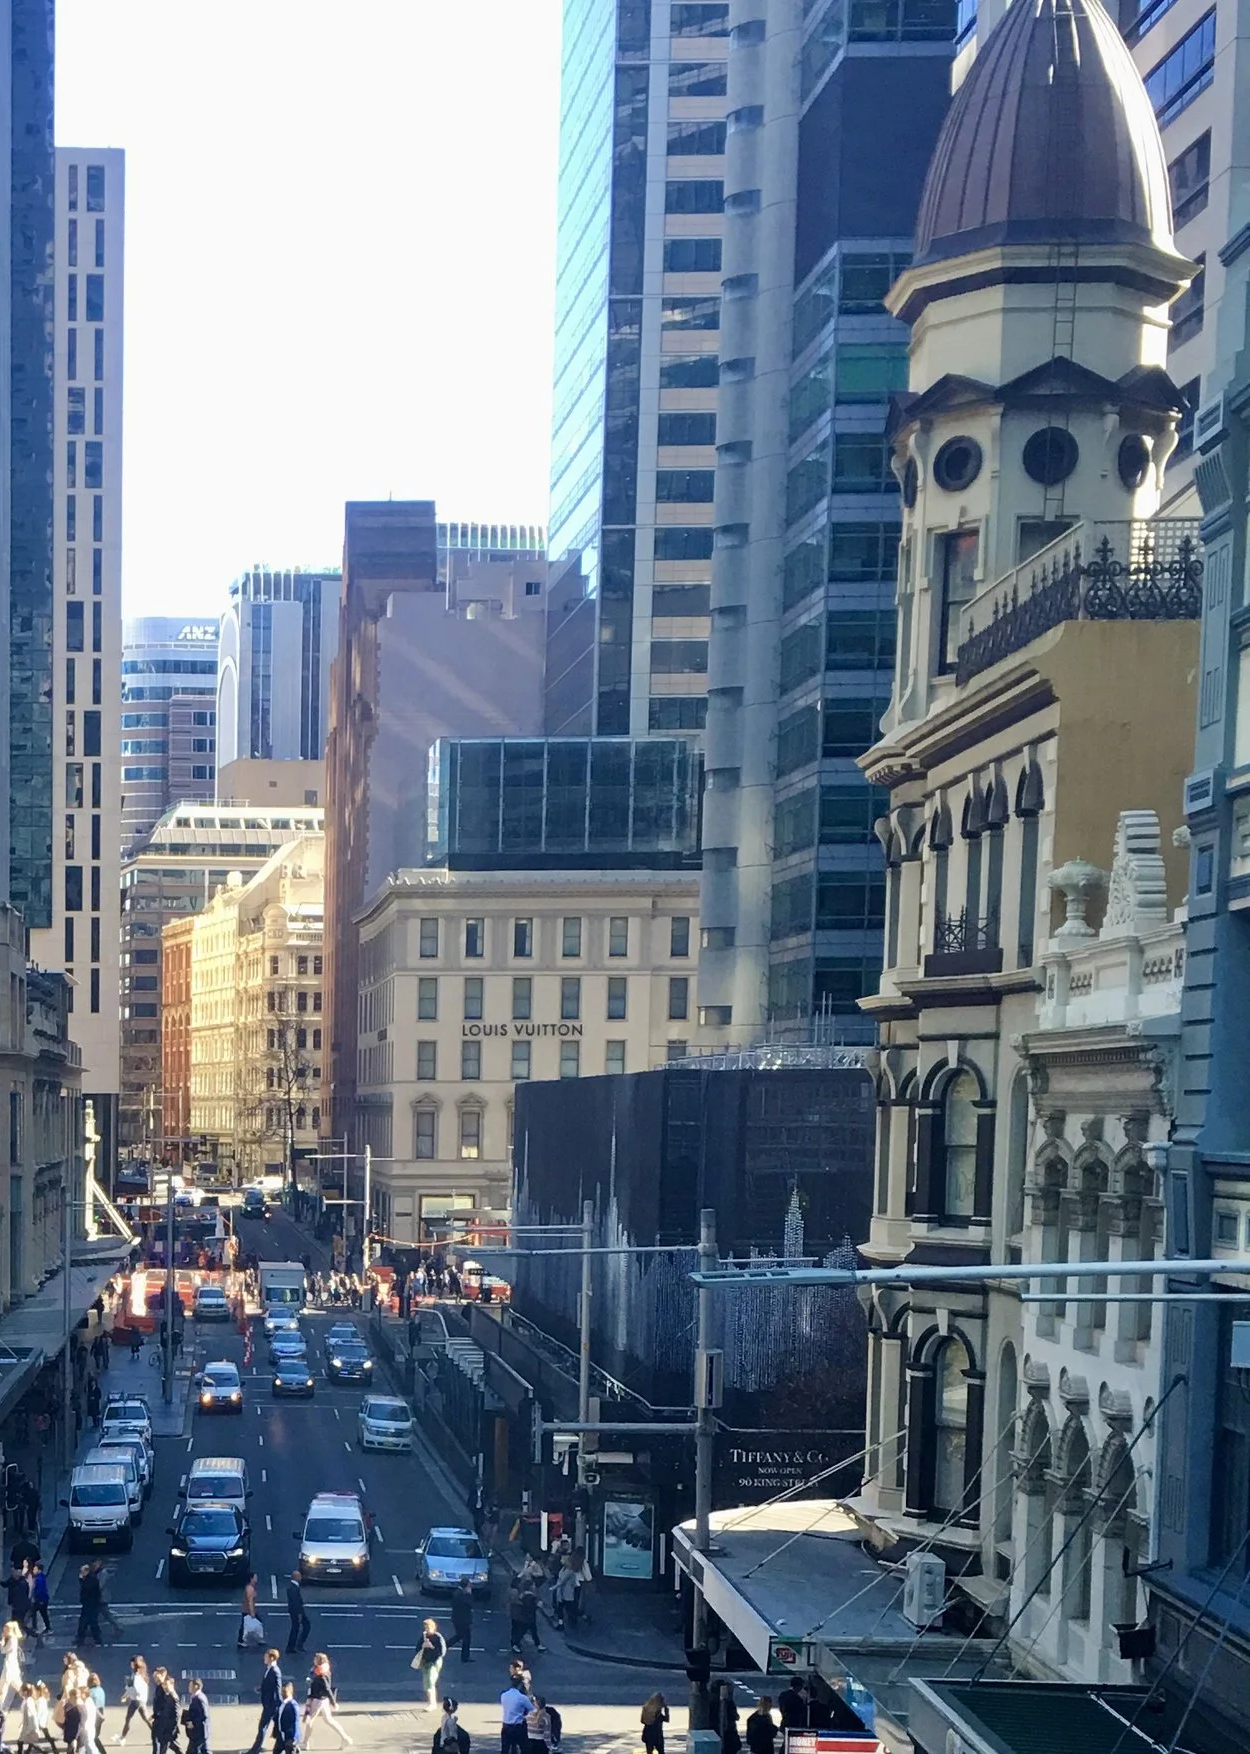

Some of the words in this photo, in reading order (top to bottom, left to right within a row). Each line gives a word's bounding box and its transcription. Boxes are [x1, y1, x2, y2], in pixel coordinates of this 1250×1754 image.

[177, 625, 216, 640] ANZ
[462, 1024, 508, 1036] LOUIS
[514, 1024, 583, 1036] VUITTON
[730, 1449, 790, 1463] TIFFANY
[793, 1451, 804, 1463] &
[758, 1467, 778, 1475] NOW
[780, 1467, 803, 1475] OPEN
[738, 1478, 753, 1487] 90
[754, 1478, 781, 1487] KING
